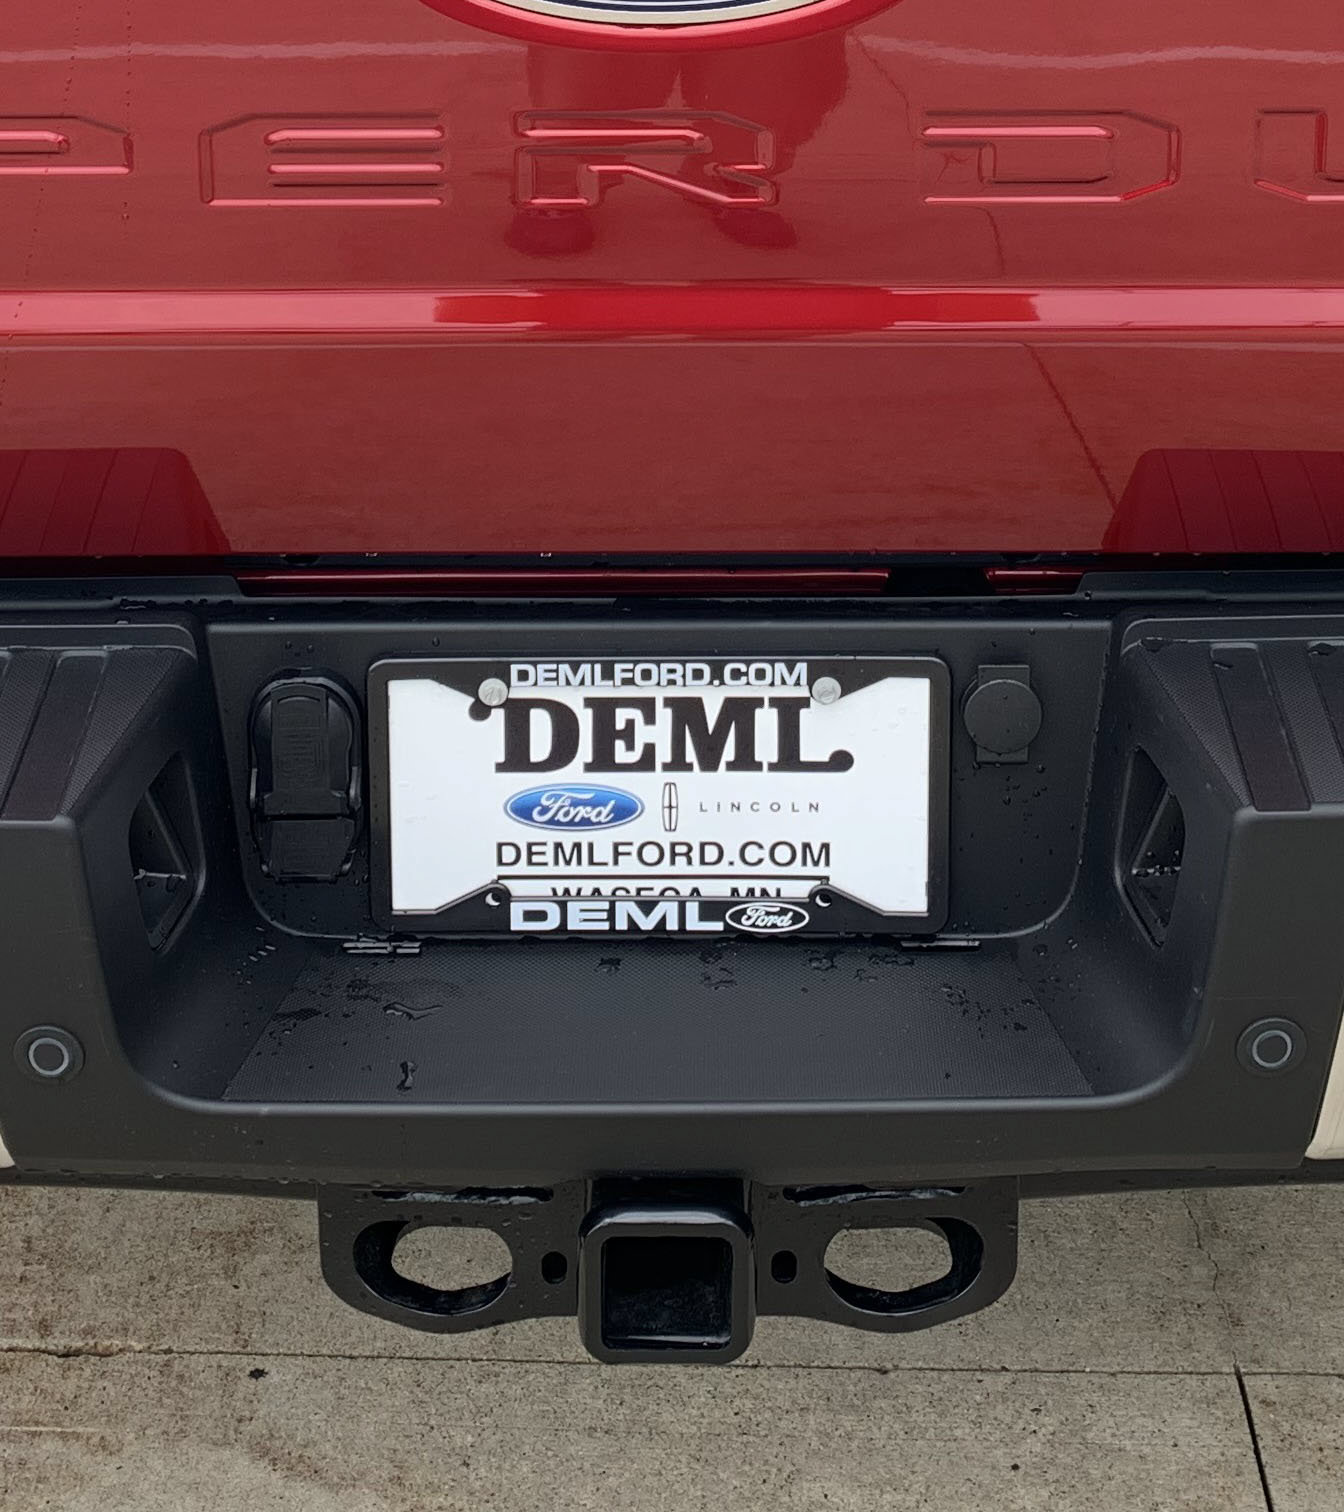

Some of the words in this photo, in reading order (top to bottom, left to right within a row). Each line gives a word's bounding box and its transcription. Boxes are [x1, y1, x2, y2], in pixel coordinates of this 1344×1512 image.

[509, 663, 808, 687] DEMLFORD.COM
[469, 696, 854, 773] DEML
[699, 801, 820, 814] LINCOLN
[496, 841, 831, 868] DEMLFORD.COM
[509, 901, 724, 931] DEML
